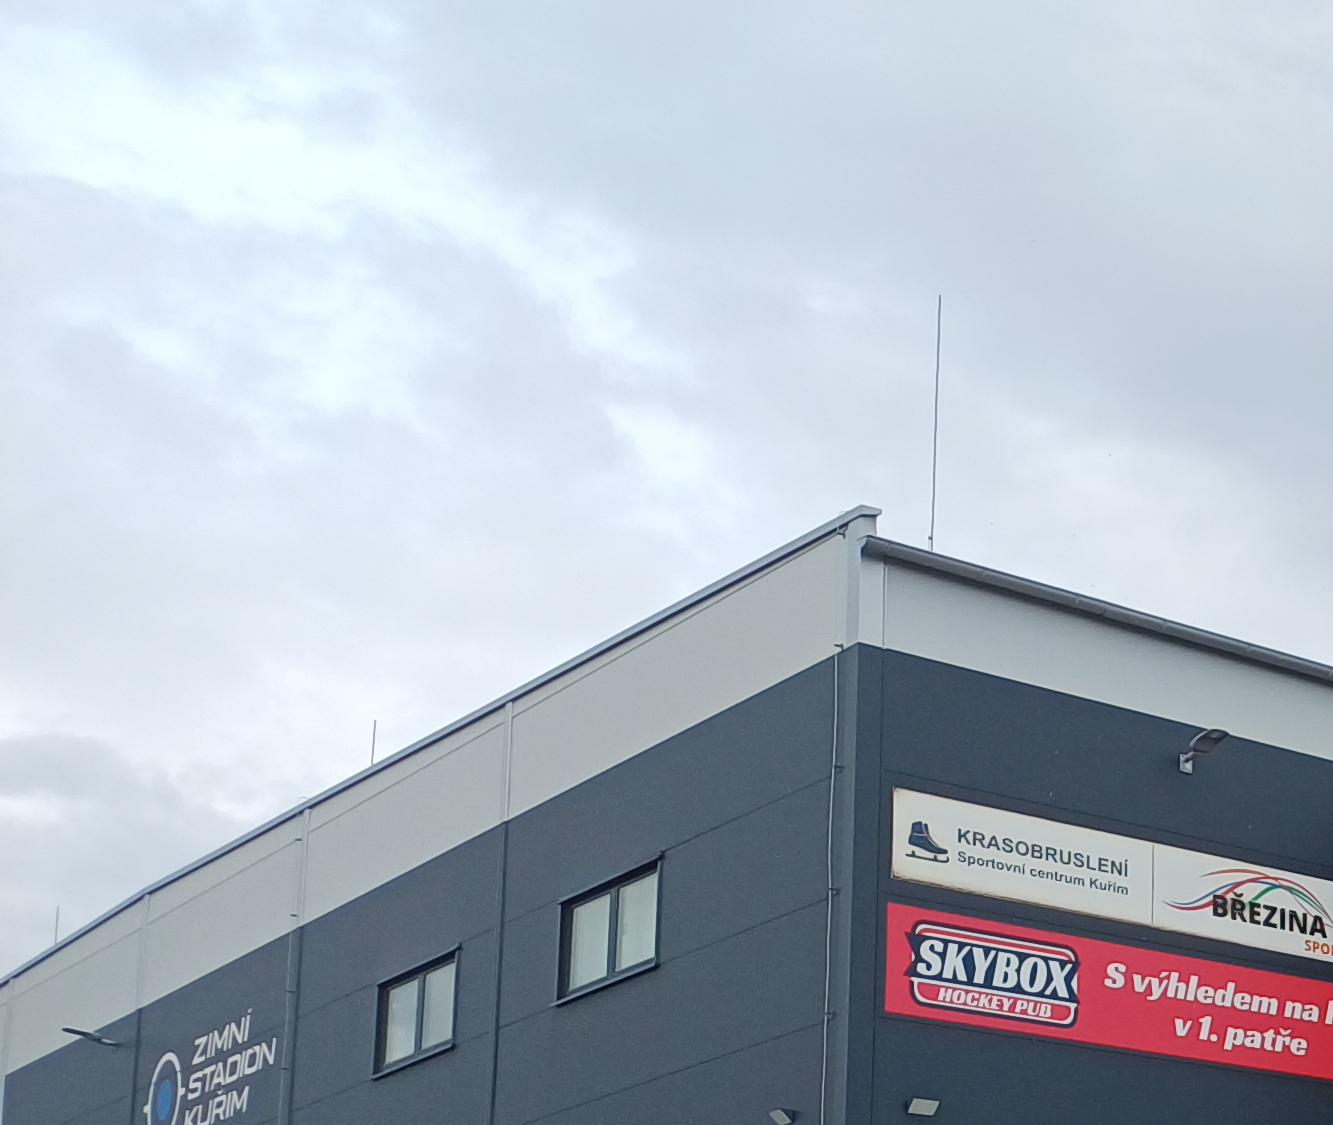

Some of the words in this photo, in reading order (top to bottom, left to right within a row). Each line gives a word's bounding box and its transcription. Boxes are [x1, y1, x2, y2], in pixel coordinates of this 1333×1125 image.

[957, 828, 1128, 877] KRASOBRUSLENÍ
[957, 851, 1025, 876] Sportovní
[1030, 867, 1085, 887] centrum
[1090, 877, 1128, 896] Kuřim
[1212, 891, 1327, 938] BŘEZINA
[916, 939, 1073, 999] SKYBOX
[1103, 962, 1127, 989] S
[1132, 971, 1279, 1015] výhledem
[1284, 1000, 1319, 1023] na
[937, 987, 1014, 1012] HOCKEY
[191, 1008, 253, 1066] ZIMNÍ
[1174, 1017, 1193, 1037] v
[1198, 1015, 1218, 1042] 1.
[1223, 1026, 1308, 1056] patře
[187, 1037, 277, 1100] STADION
